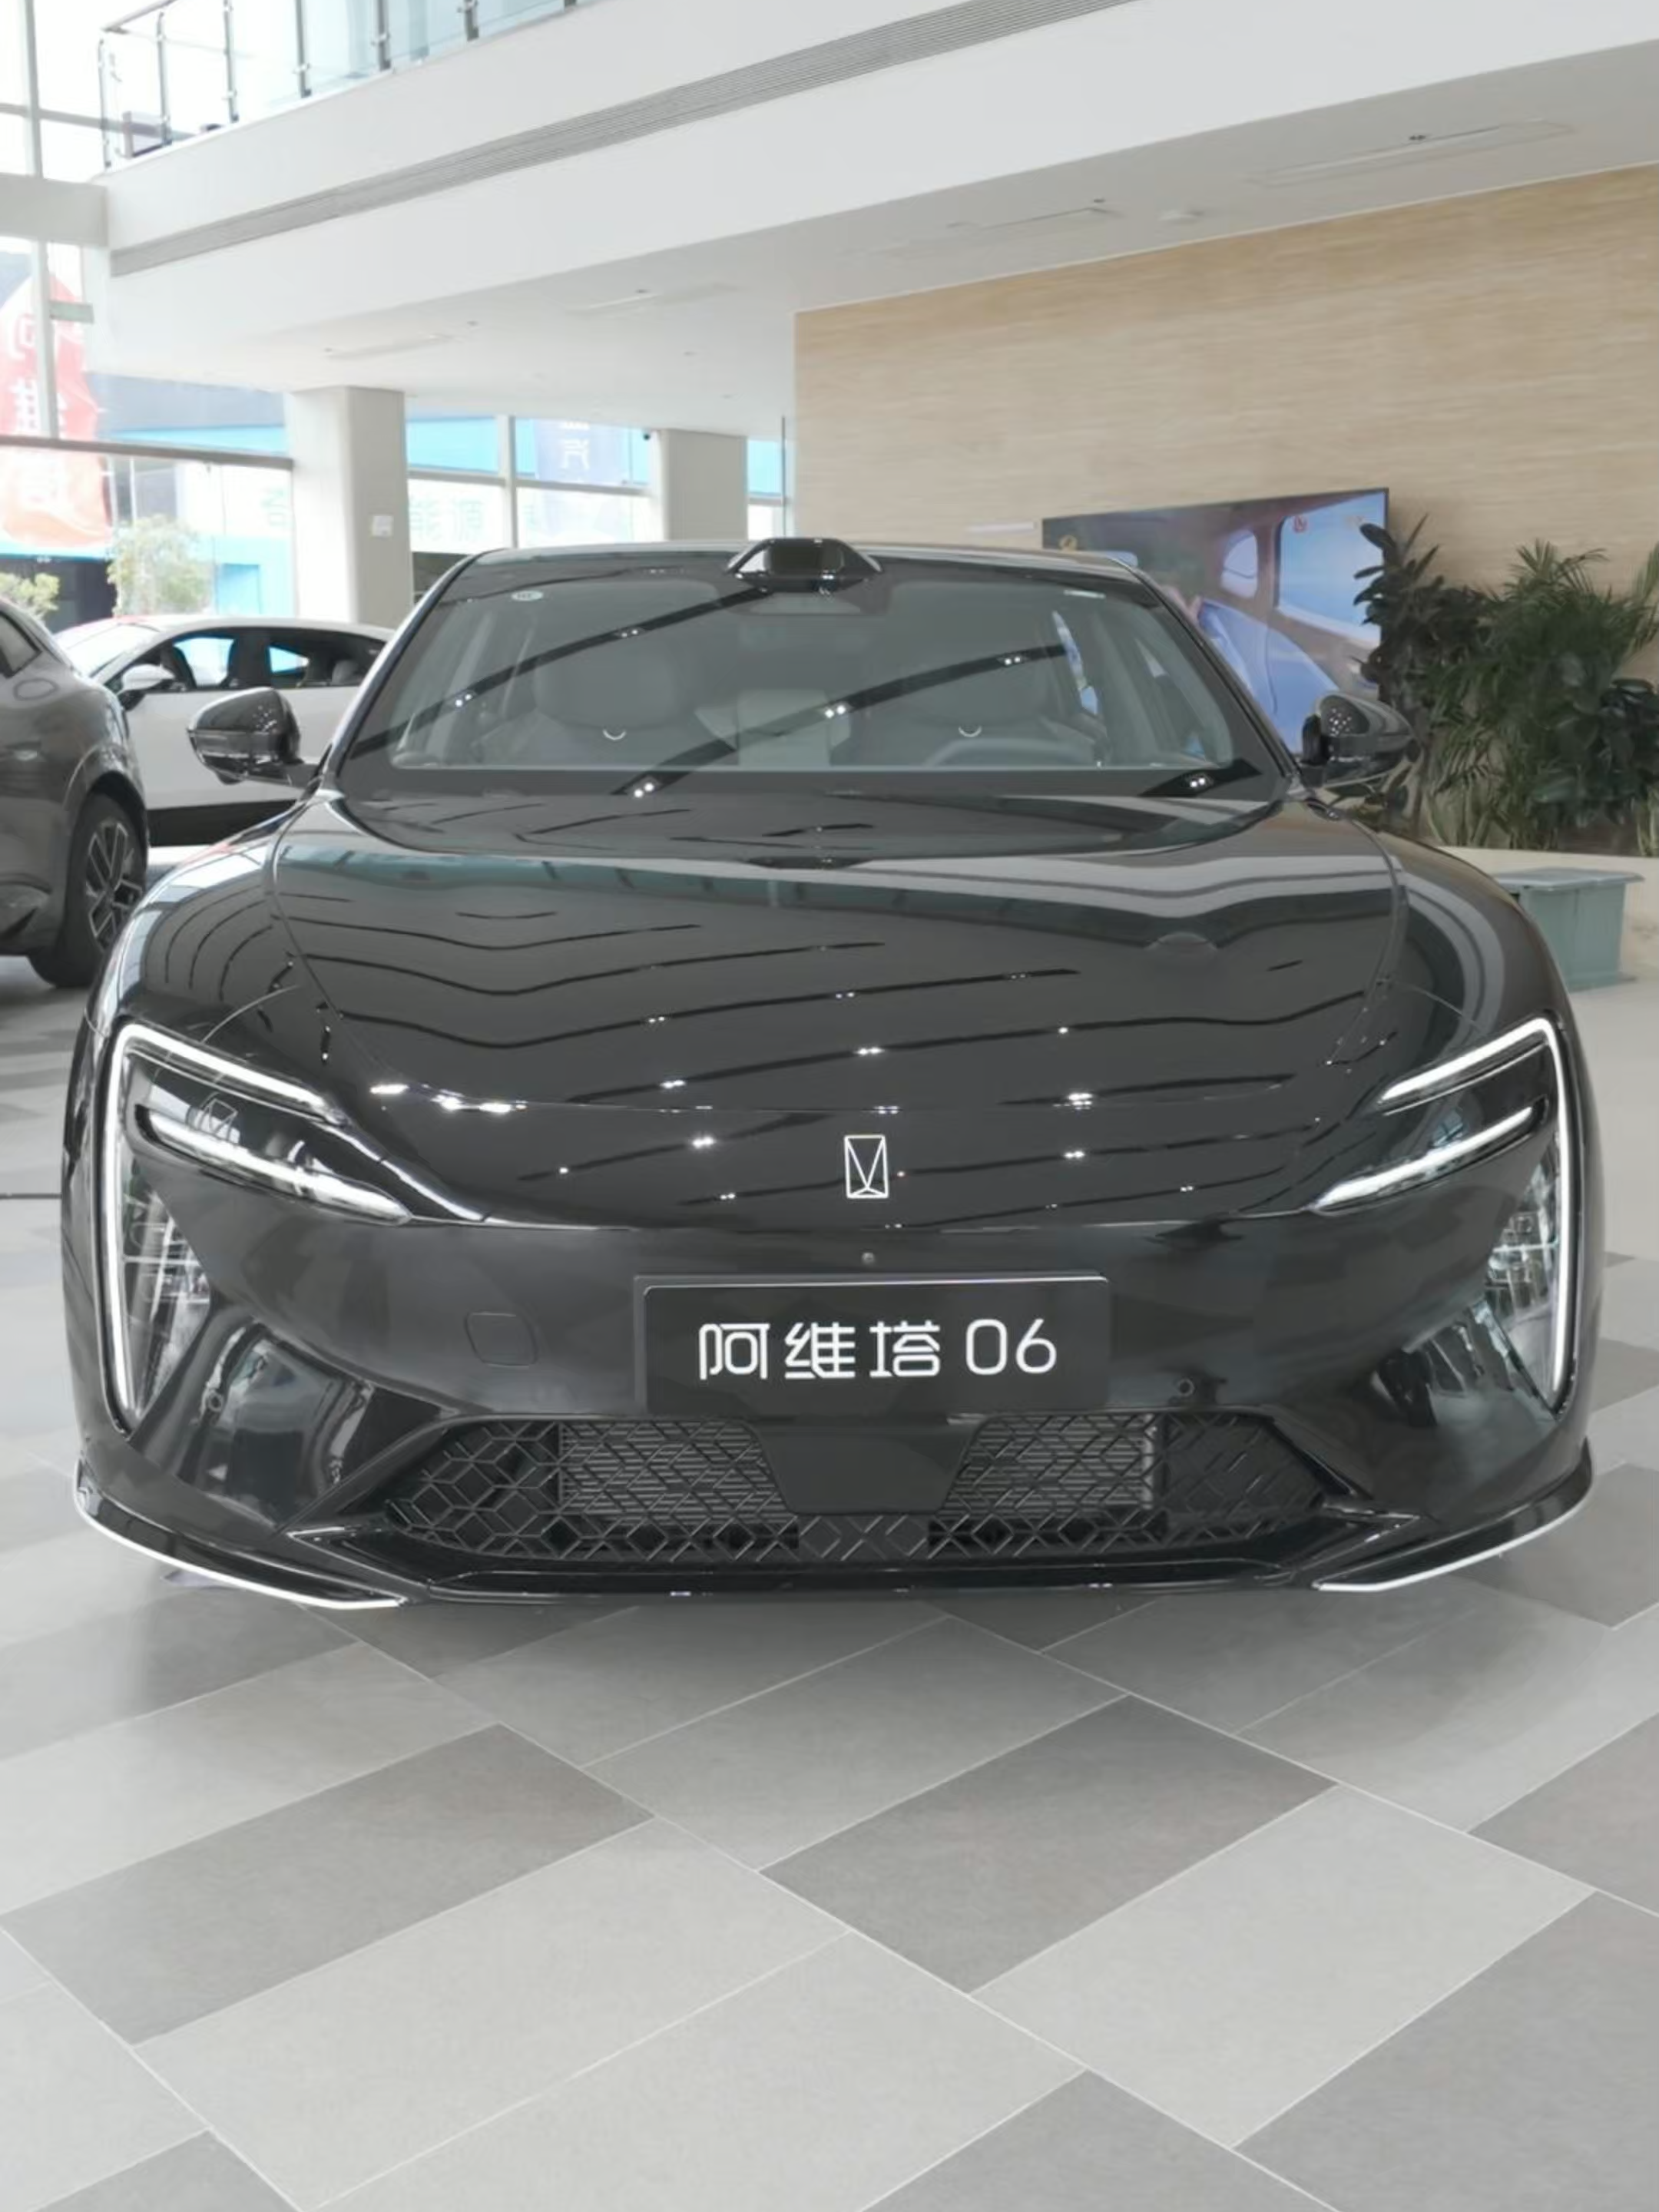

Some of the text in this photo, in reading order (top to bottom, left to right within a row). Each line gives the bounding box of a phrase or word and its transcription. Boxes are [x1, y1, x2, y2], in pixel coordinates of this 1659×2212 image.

[698, 1318, 1058, 1380] 阿维塔 06
